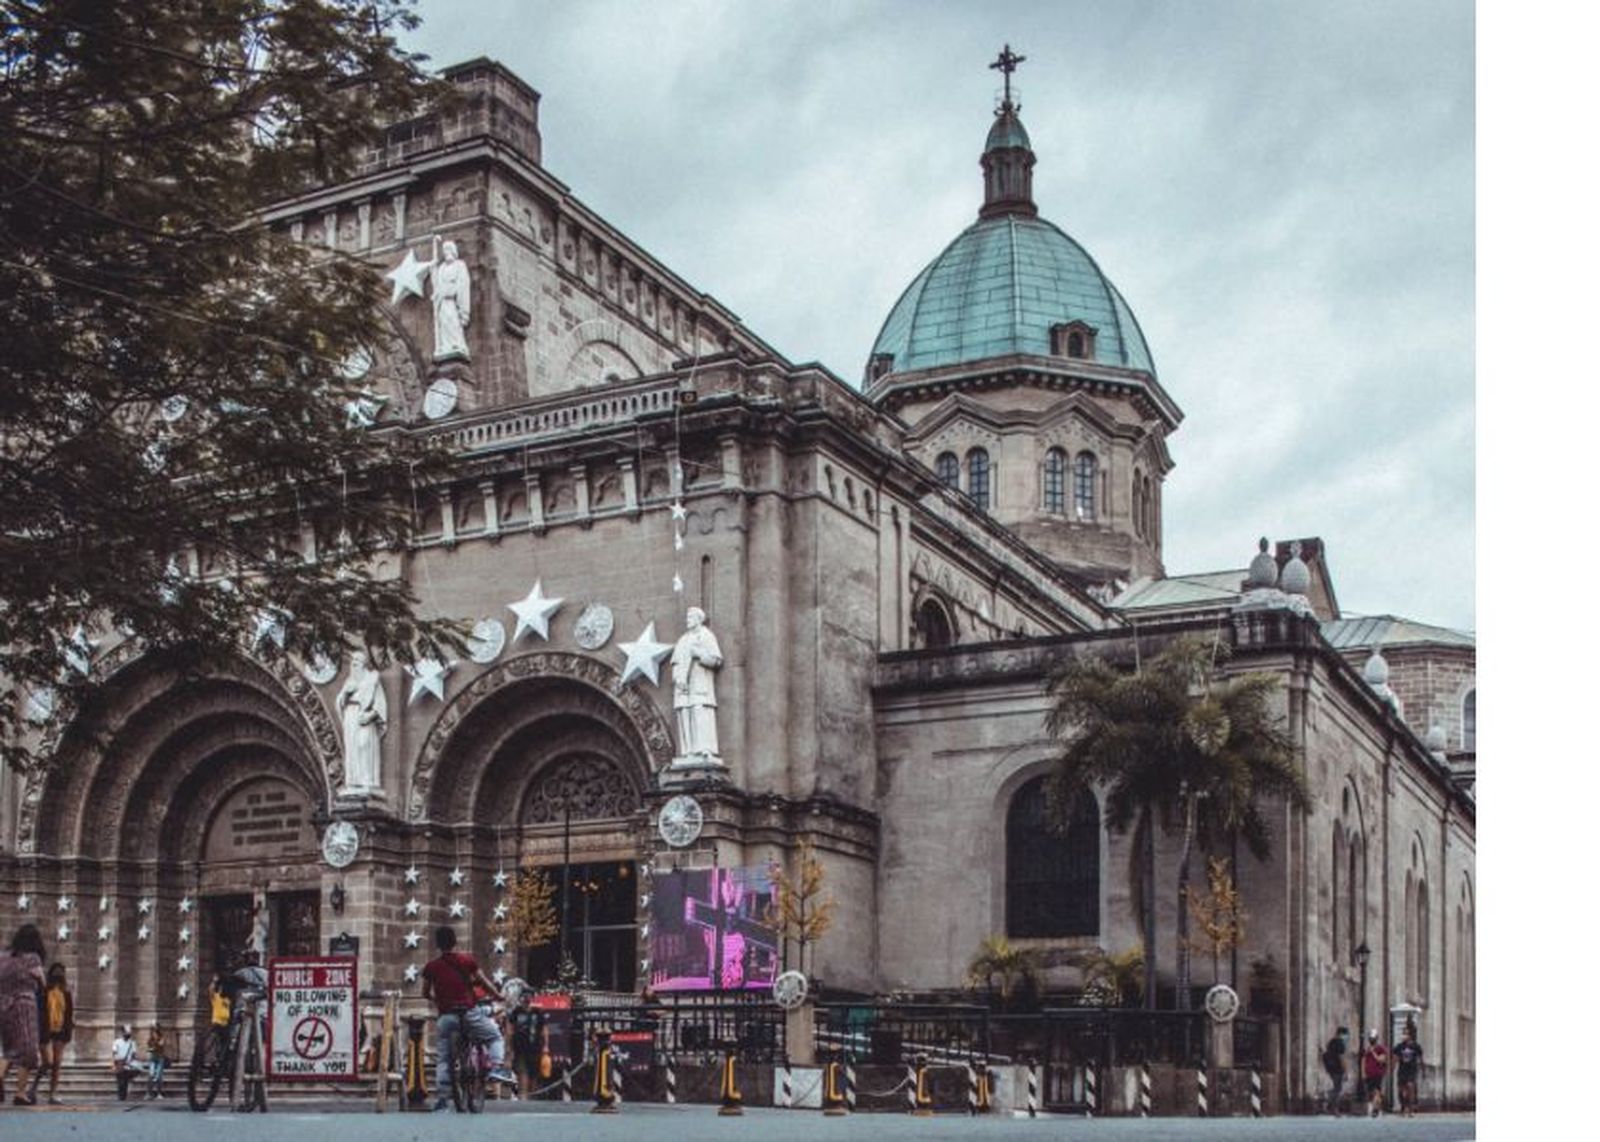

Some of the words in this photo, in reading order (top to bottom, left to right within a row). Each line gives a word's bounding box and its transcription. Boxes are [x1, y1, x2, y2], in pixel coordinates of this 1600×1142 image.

[275, 969, 313, 986] CHURCH
[325, 969, 352, 985] ZONE
[276, 991, 291, 1002] NO
[295, 989, 348, 1003] BLOWING
[288, 1005, 303, 1017] OF
[308, 1005, 339, 1017] HORN
[276, 1061, 316, 1073] THANK
[323, 1061, 347, 1072] YOU
